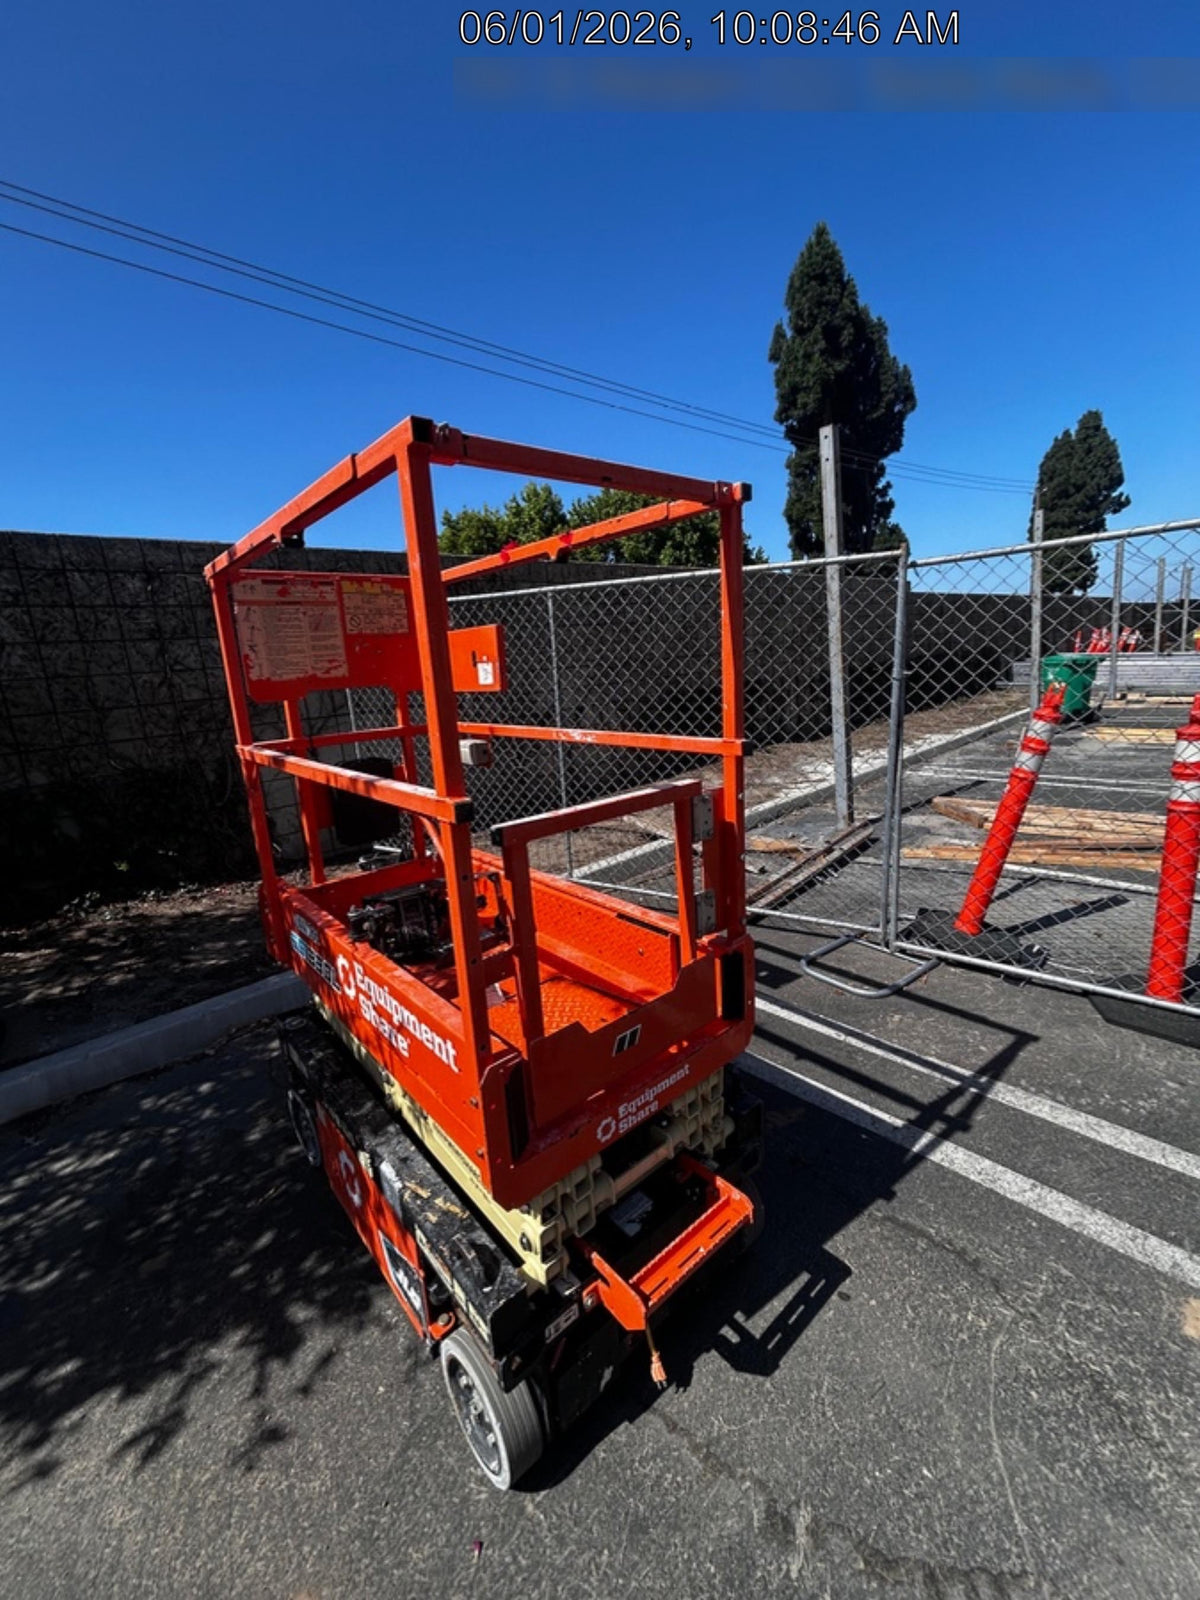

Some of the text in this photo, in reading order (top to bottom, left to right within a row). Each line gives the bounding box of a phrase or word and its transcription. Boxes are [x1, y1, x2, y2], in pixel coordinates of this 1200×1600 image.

[353, 961, 459, 1073] Equipment
[358, 993, 410, 1058] Share
[617, 1064, 691, 1119] Equipment
[617, 1100, 659, 1134] Share
